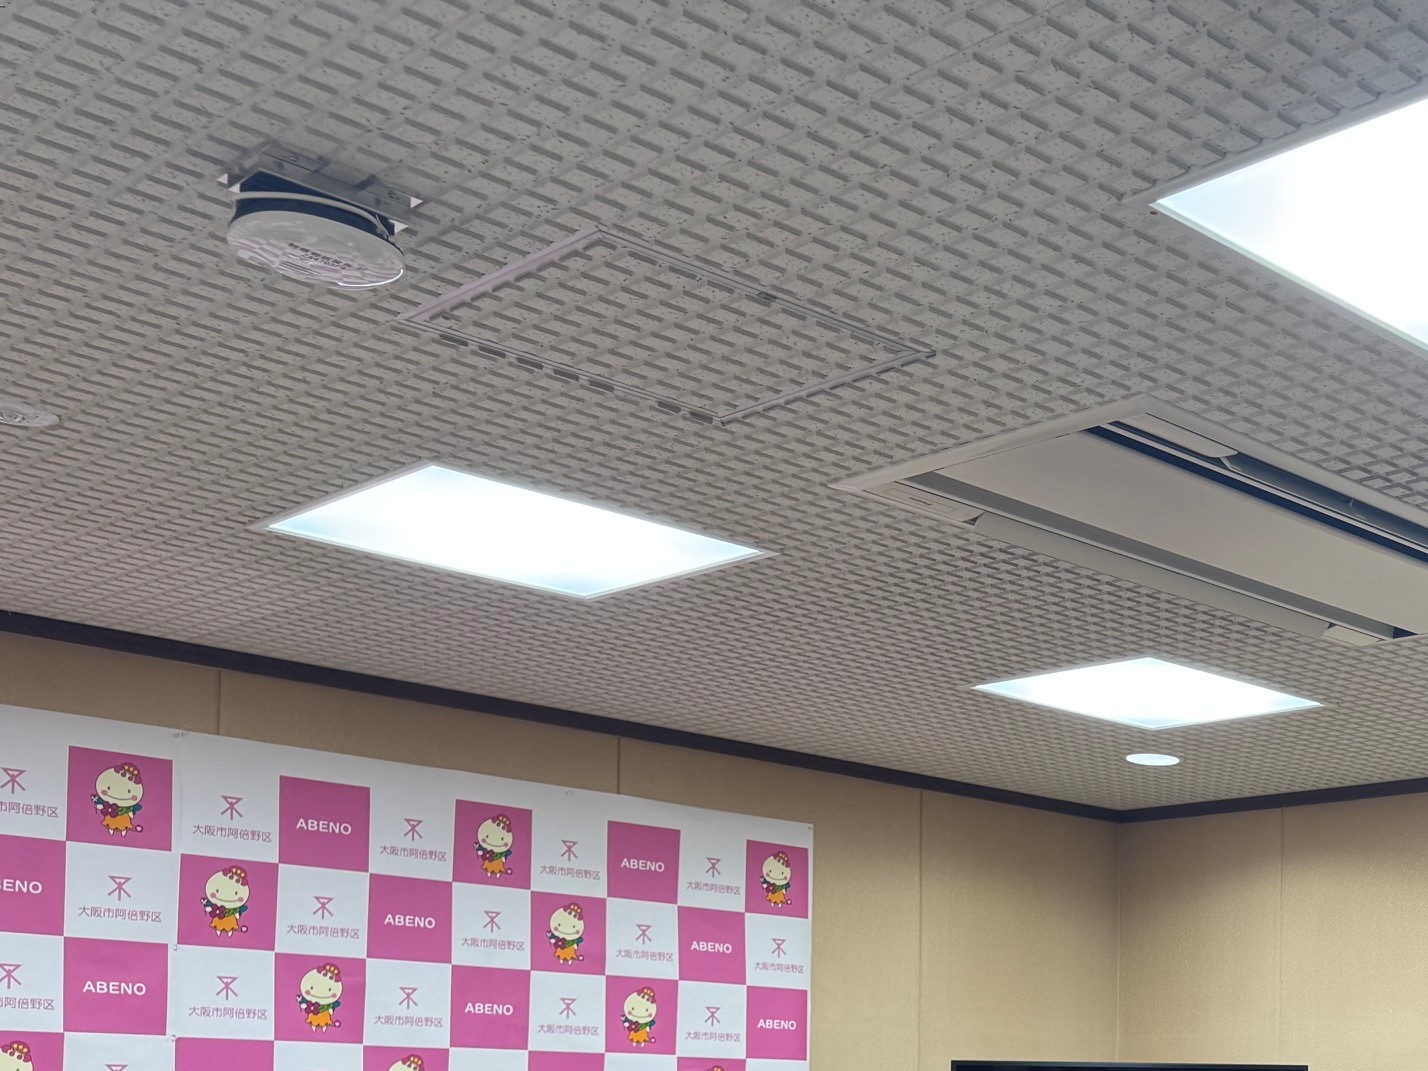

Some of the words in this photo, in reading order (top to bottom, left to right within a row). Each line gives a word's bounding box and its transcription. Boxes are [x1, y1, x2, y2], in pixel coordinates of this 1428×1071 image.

[193, 825, 271, 842] 大阪市阿倍野区
[297, 819, 351, 834] ABENO
[381, 845, 446, 861] 大阪市阿倍野区
[621, 859, 664, 871] ABENO
[0, 879, 42, 893] ENO
[79, 906, 161, 922] 大阪市阿倍野区
[385, 914, 435, 928] ABENO
[287, 924, 359, 939] 大阪市阿倍野区
[462, 937, 525, 951] 大阪市阿倍野区
[691, 941, 731, 953] ABENO
[83, 981, 146, 995] ABENO
[0, 997, 54, 1010] 阿倍野区
[465, 1003, 513, 1015] ABENO
[189, 1006, 267, 1020] 大阪市阿倍野区
[375, 1015, 442, 1027] 大阪市阿倍野区
[758, 1019, 796, 1030] ABENO
